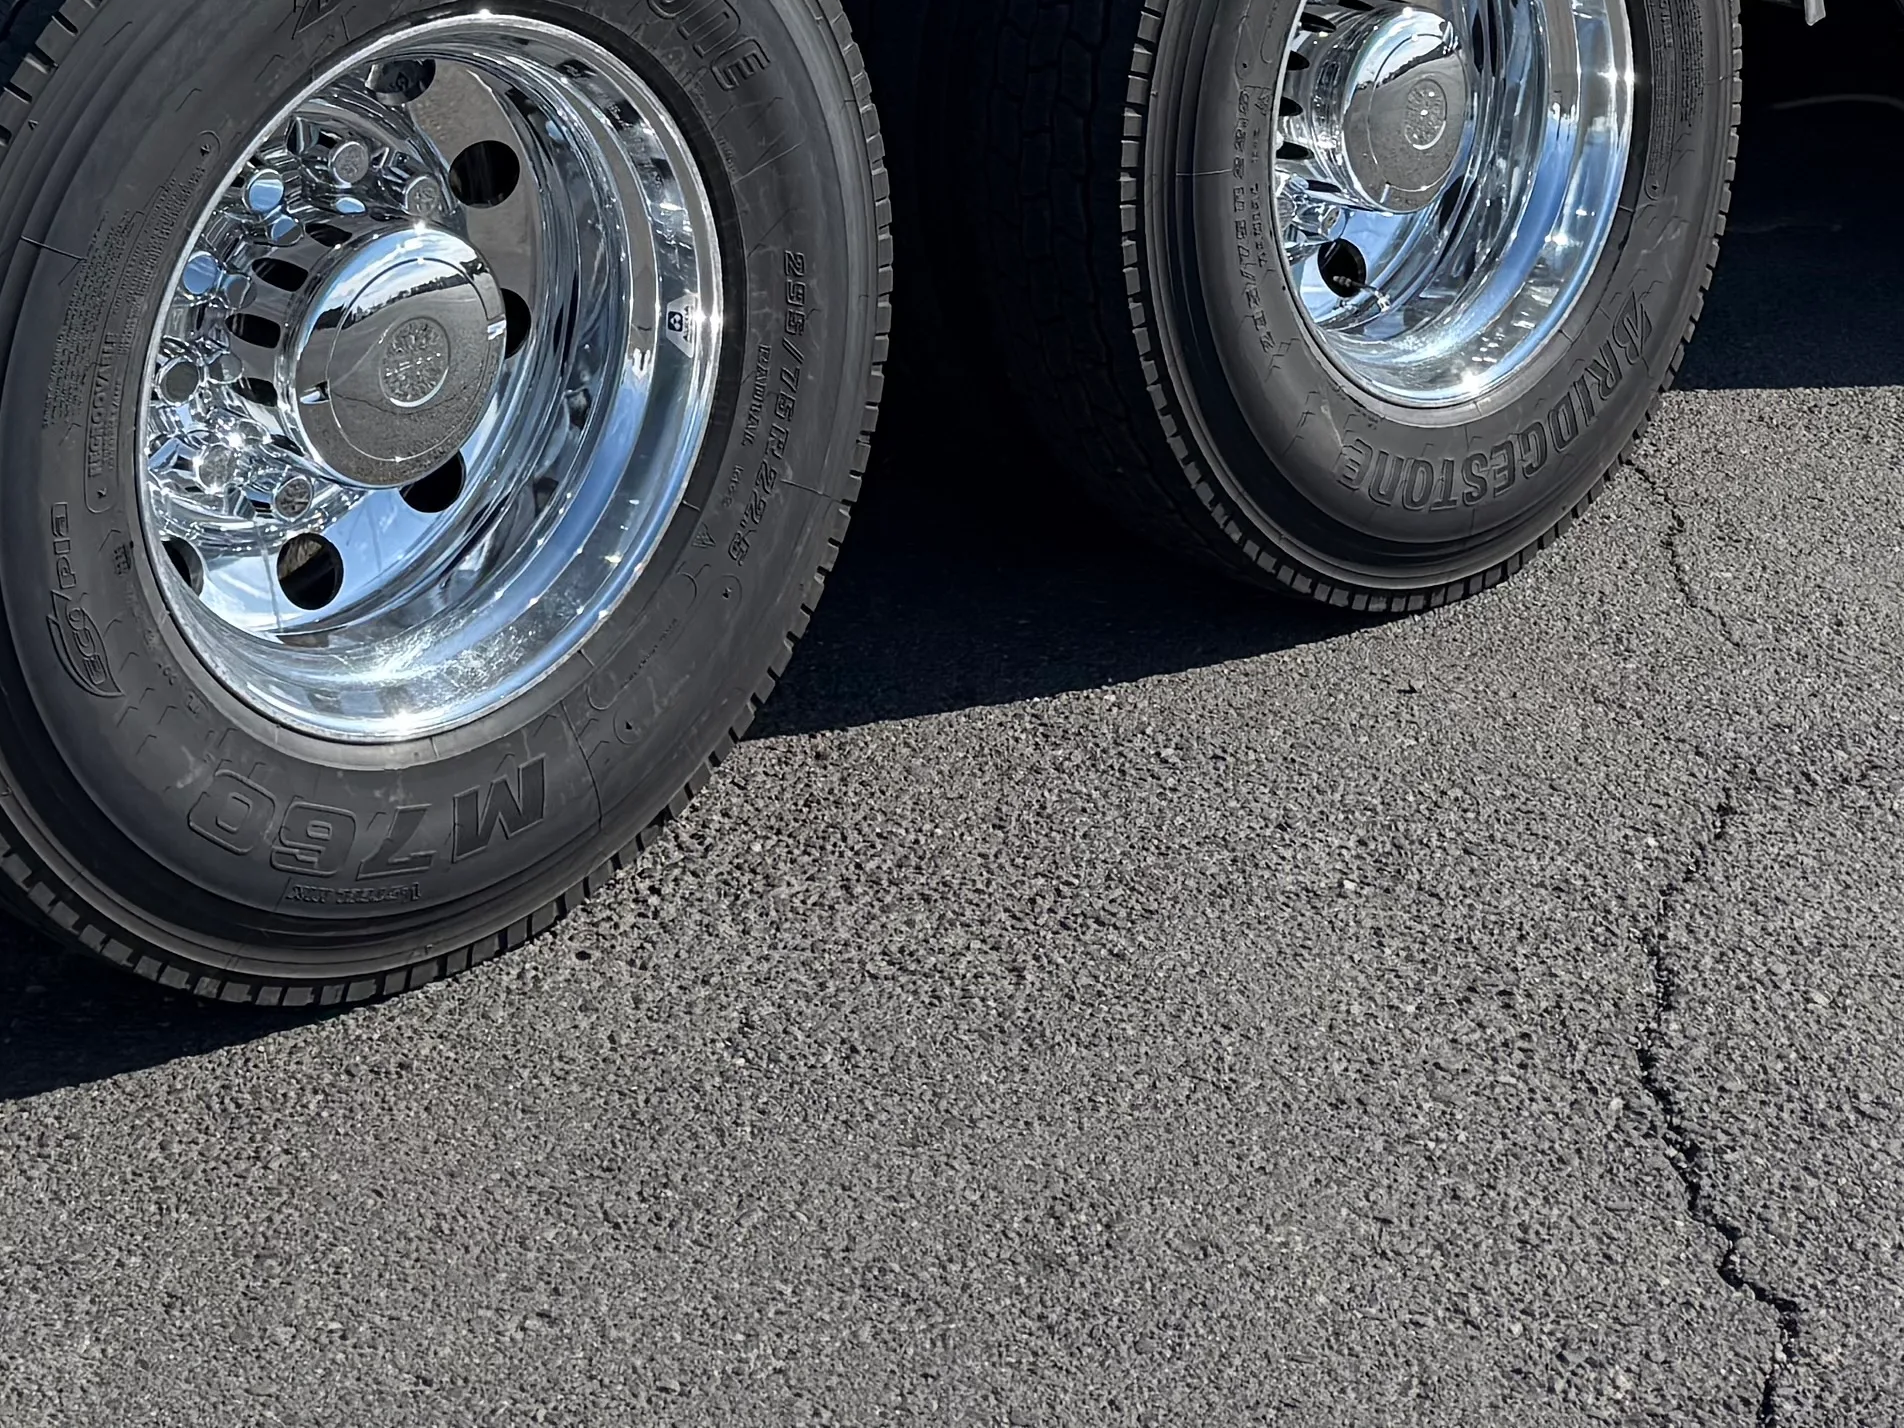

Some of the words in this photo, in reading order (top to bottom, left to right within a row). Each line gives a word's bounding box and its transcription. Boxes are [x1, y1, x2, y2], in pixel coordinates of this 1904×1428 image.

[739, 344, 774, 449] RADIAL
[1334, 290, 1656, 513] BRIDGESTONE
[187, 756, 547, 882] M760
